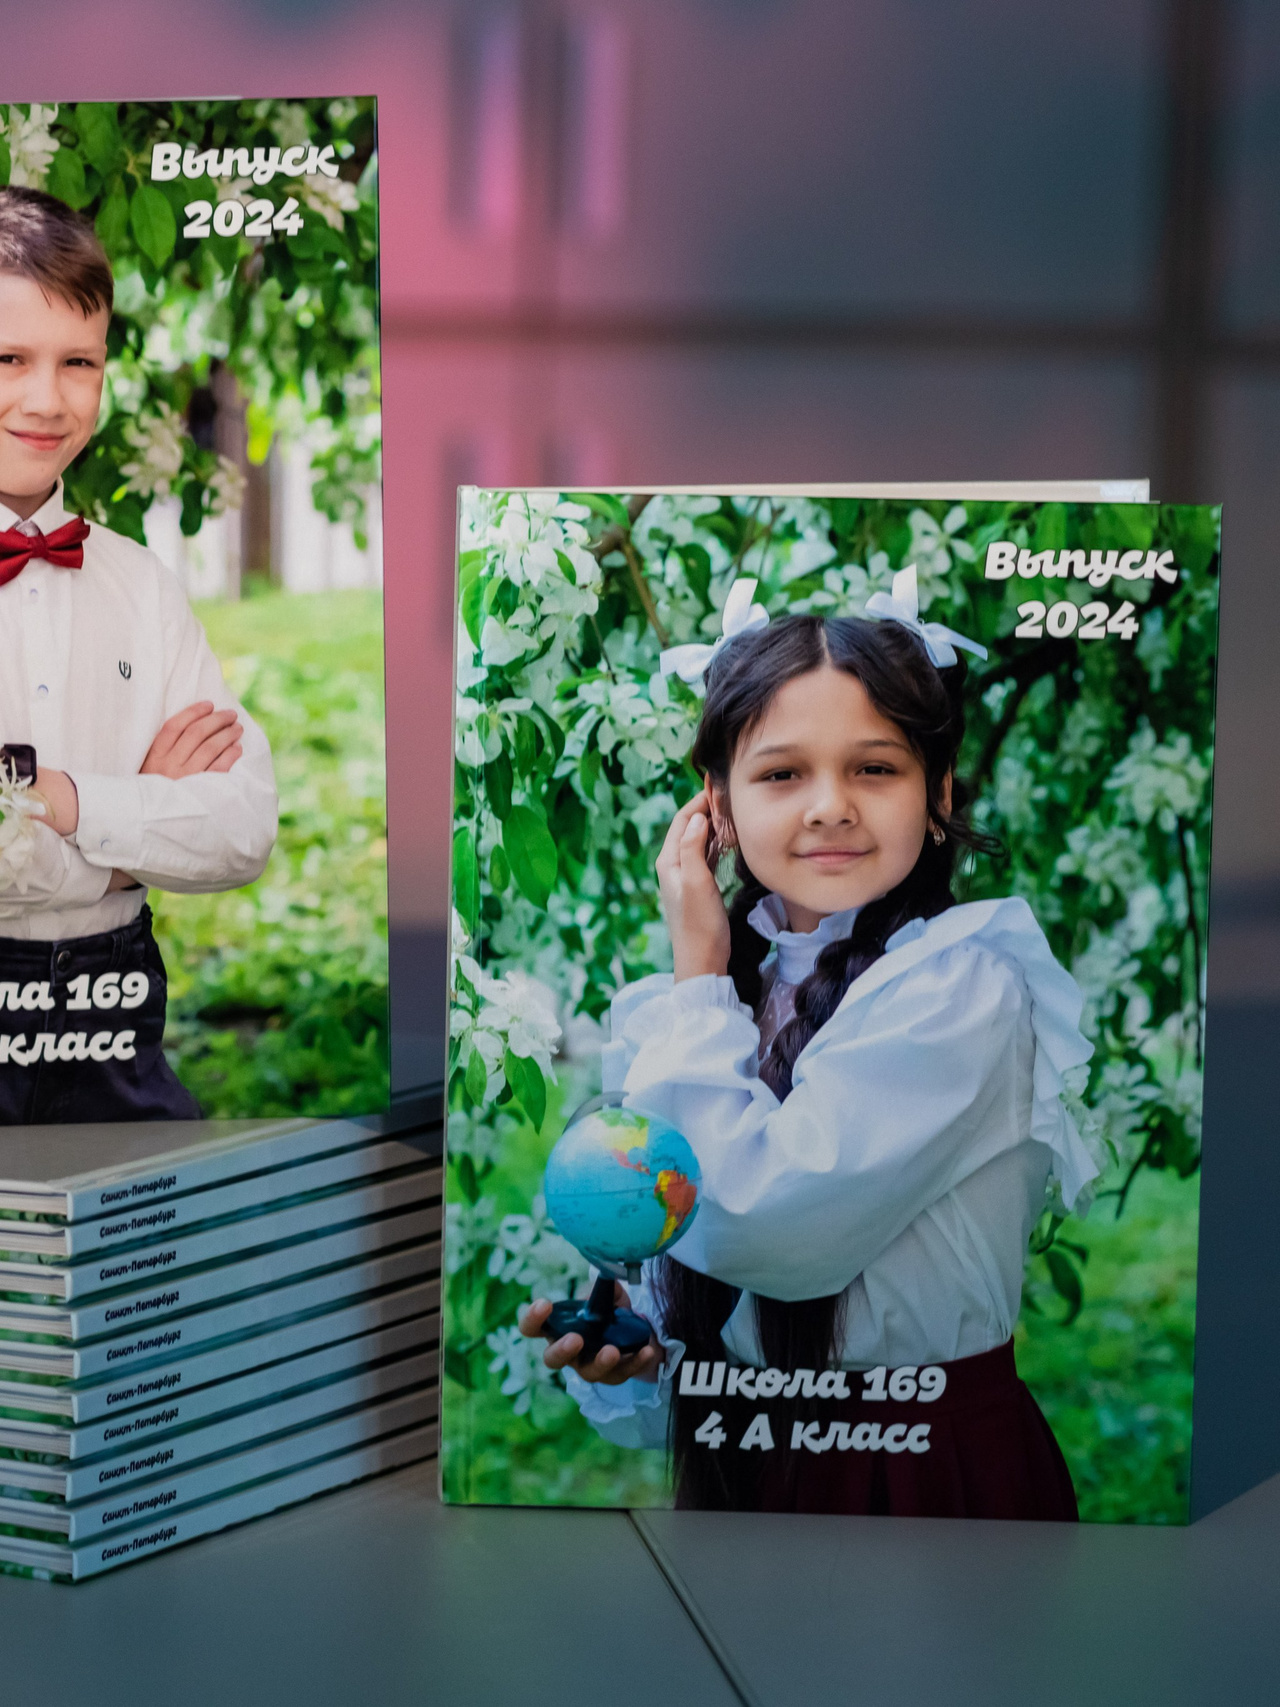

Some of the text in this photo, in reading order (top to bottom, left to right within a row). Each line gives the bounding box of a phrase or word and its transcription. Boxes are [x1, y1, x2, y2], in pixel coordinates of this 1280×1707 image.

[151, 142, 339, 186] Выпуск
[183, 197, 304, 238] 2024
[984, 541, 1178, 588] Выпуск
[1015, 600, 1139, 640] 2024
[66, 971, 150, 1010] 169
[100, 1175, 176, 1204] Санкт-Петербург
[100, 1208, 176, 1238] Санкт-Петербург
[100, 1250, 176, 1280] Санкт-Петербург
[104, 1290, 180, 1322] Санкт-Петербург
[106, 1329, 181, 1362] Санкт-Петербург
[106, 1372, 181, 1405] Санкт-Петербург
[678, 1361, 947, 1402] Школа 169
[104, 1407, 179, 1441] Санкт-Петербург
[694, 1410, 727, 1449] 4
[790, 1420, 931, 1454] класс
[98, 1448, 174, 1483] Санкт-Петербург
[102, 1489, 177, 1524] Санкт-Петербург
[102, 1525, 177, 1561] Санкт-Петербург
